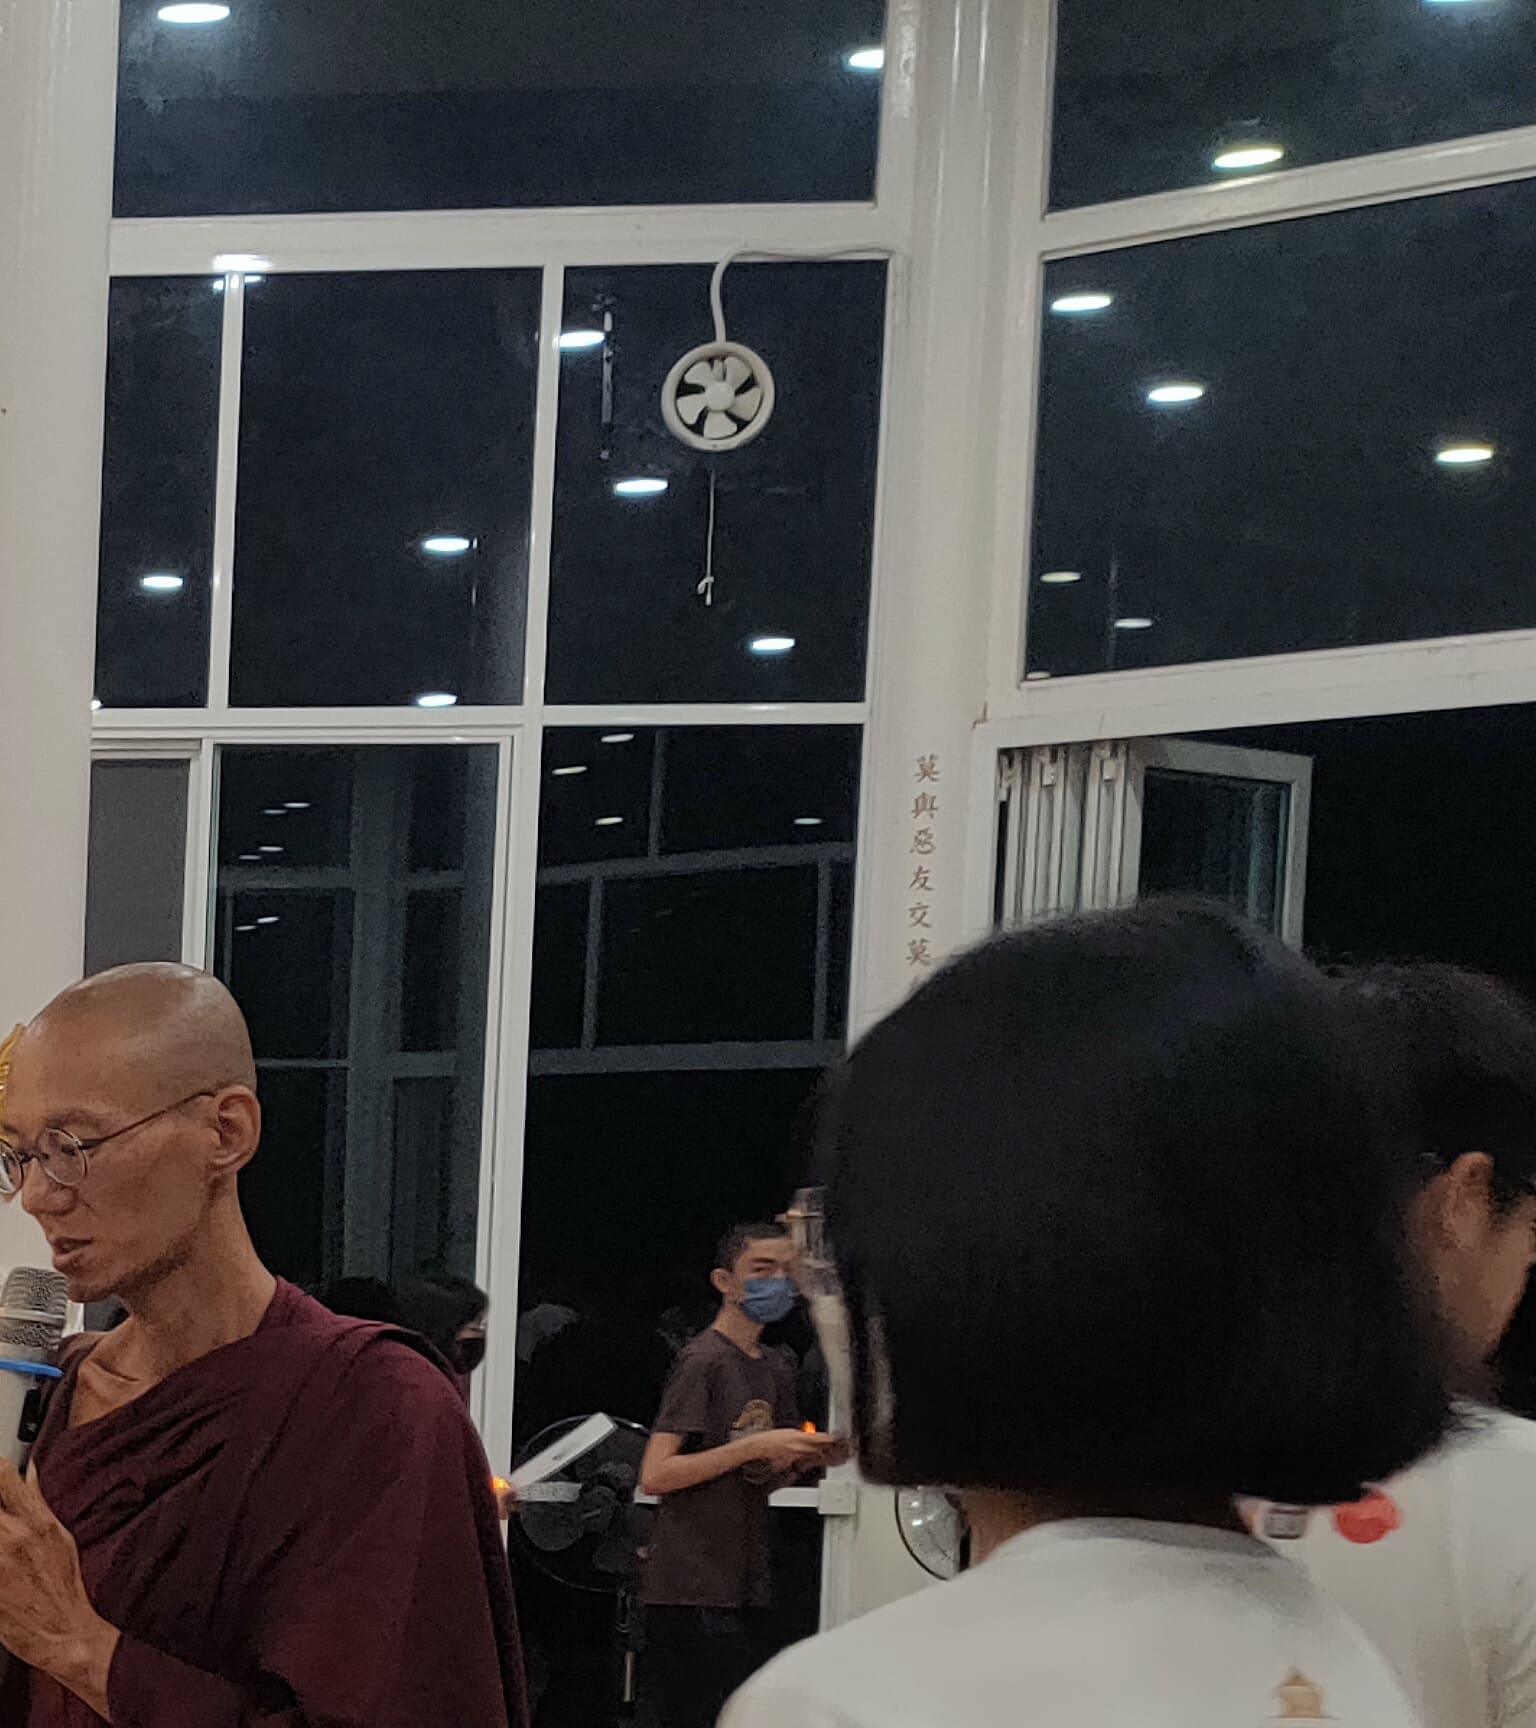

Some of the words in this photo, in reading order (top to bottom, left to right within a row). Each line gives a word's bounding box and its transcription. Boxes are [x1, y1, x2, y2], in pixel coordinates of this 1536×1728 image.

[905, 753, 940, 988] 莫與惡友交莫
